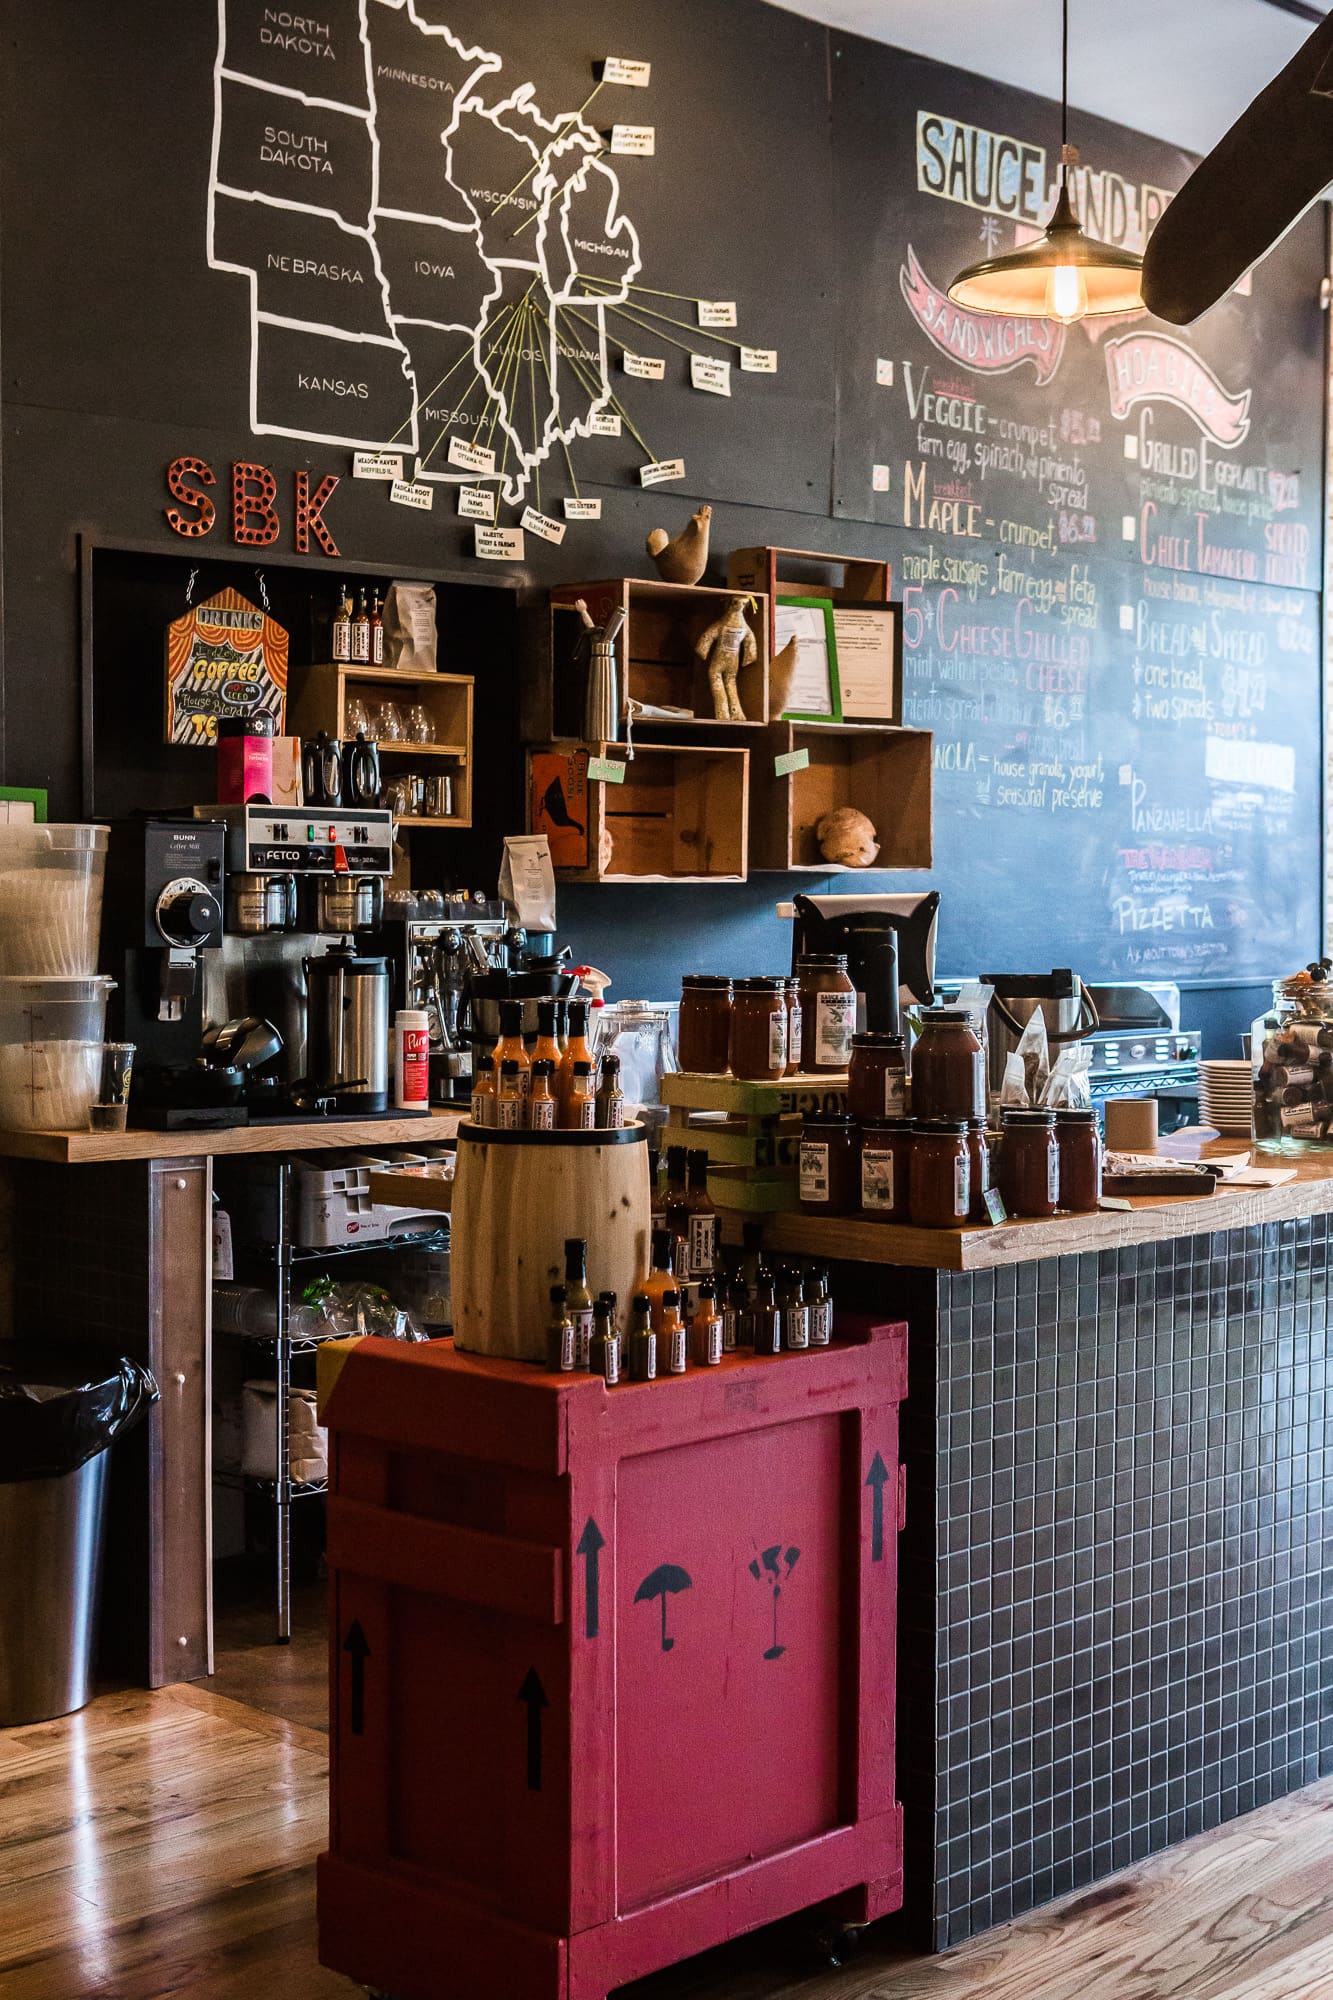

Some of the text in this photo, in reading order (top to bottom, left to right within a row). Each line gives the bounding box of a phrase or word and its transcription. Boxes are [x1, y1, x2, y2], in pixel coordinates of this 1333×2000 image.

[264, 8, 329, 38] NORTH
[260, 28, 336, 60] DAKOTA
[377, 65, 454, 93] MINNESOTA
[264, 127, 328, 153] SOUTH
[260, 146, 333, 175] DAKOTA
[921, 117, 1040, 220] SAUCE
[470, 188, 537, 210] WISCONSIN
[574, 240, 629, 258] MICHIGAN
[267, 254, 364, 284] NEBRASKA
[414, 261, 455, 279] IOWA
[921, 295, 1053, 360] SANDWICHES
[556, 345, 600, 361] INDIANA
[299, 374, 369, 399] KANSAS
[1116, 349, 1214, 416] HOAGIES
[902, 360, 986, 435] VEGGIE
[425, 407, 493, 427] MISSOURI
[917, 422, 943, 456] farm
[1140, 407, 1198, 480] GRILLED
[357, 457, 378, 465] MEADOW
[474, 448, 492, 460] FARMS
[360, 466, 387, 474] SHEFFIELD
[394, 483, 430, 497] RADICAL ROOT
[468, 499, 483, 507] FARMS
[903, 460, 982, 538] MAPLE
[1047, 483, 1088, 511] spread
[165, 456, 342, 557] SBK
[199, 608, 262, 630] DRINKS
[902, 586, 924, 649] 5
[193, 660, 258, 681] COFFEE
[905, 647, 933, 680] mint
[1144, 664, 1169, 689] one
[182, 694, 211, 709] House
[227, 691, 249, 699] ICED
[190, 714, 219, 738] TE
[934, 742, 977, 772] NOLA
[993, 758, 1025, 778] house
[1052, 784, 1104, 813] preserve
[1131, 772, 1214, 834] PANZANELLA
[266, 851, 300, 860] FETCO
[1112, 895, 1215, 936] PIZZETTA
